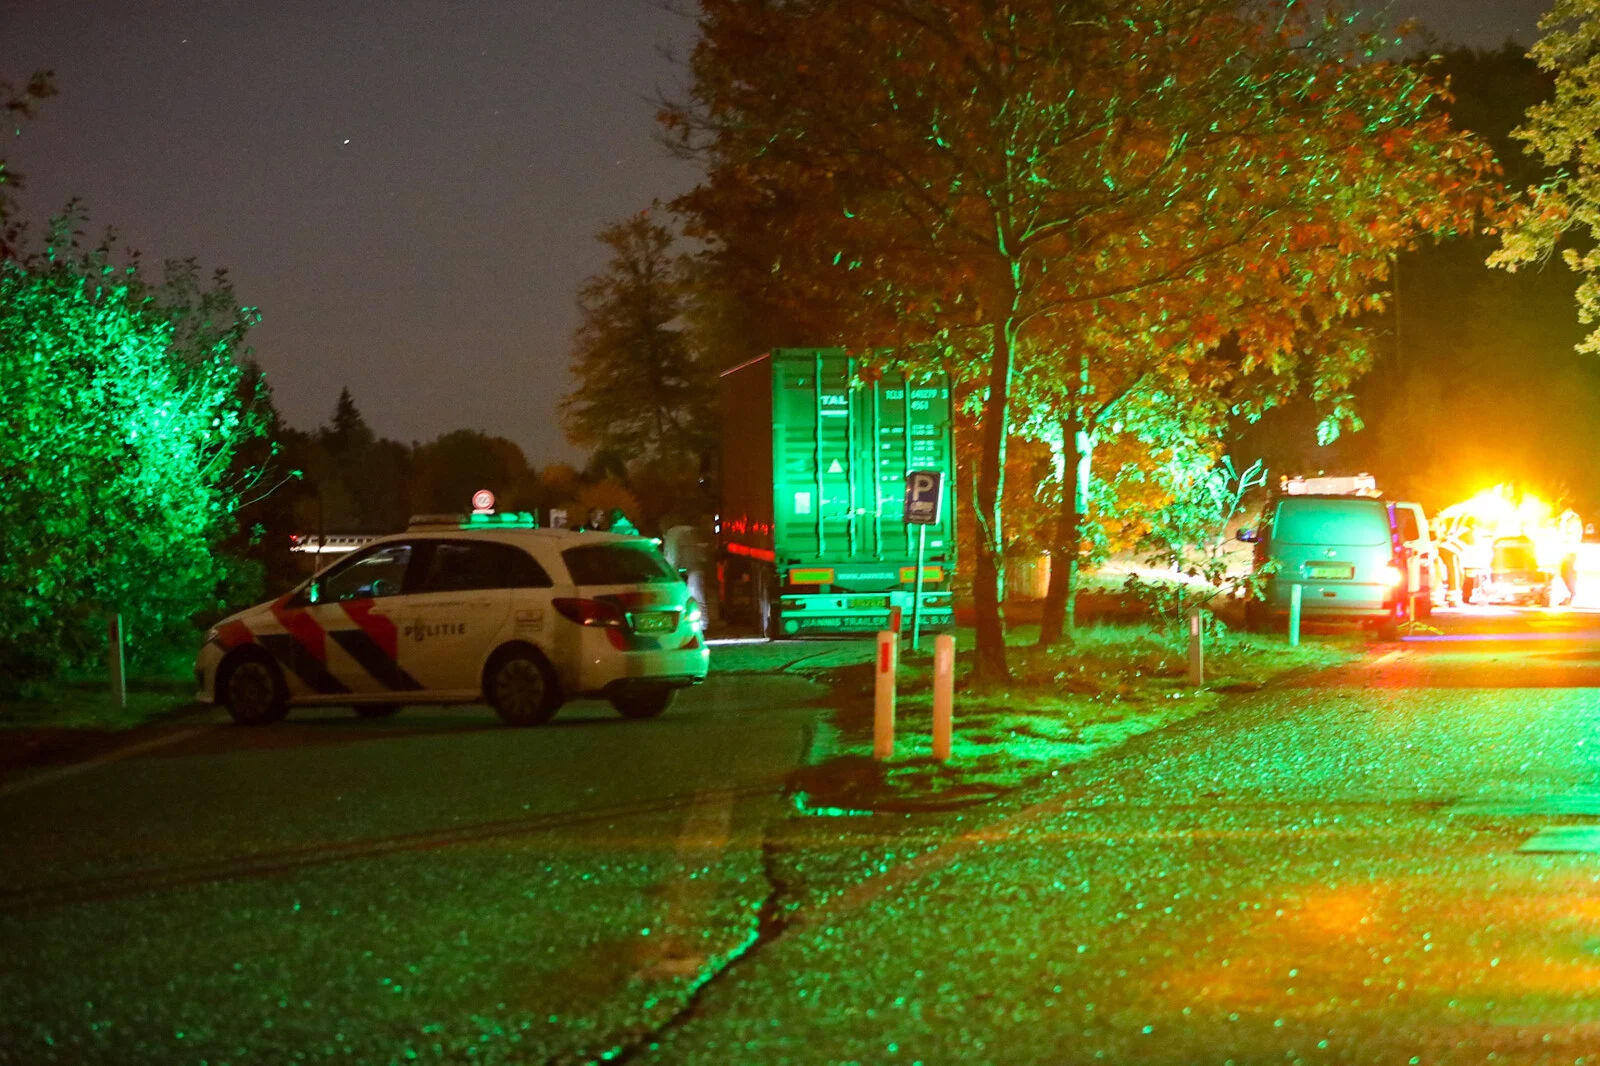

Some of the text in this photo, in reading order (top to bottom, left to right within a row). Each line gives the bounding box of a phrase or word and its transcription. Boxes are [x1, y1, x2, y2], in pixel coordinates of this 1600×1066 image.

[820, 395, 848, 405] TAL
[912, 475, 934, 501] P
[843, 616, 887, 627] TRAILER
